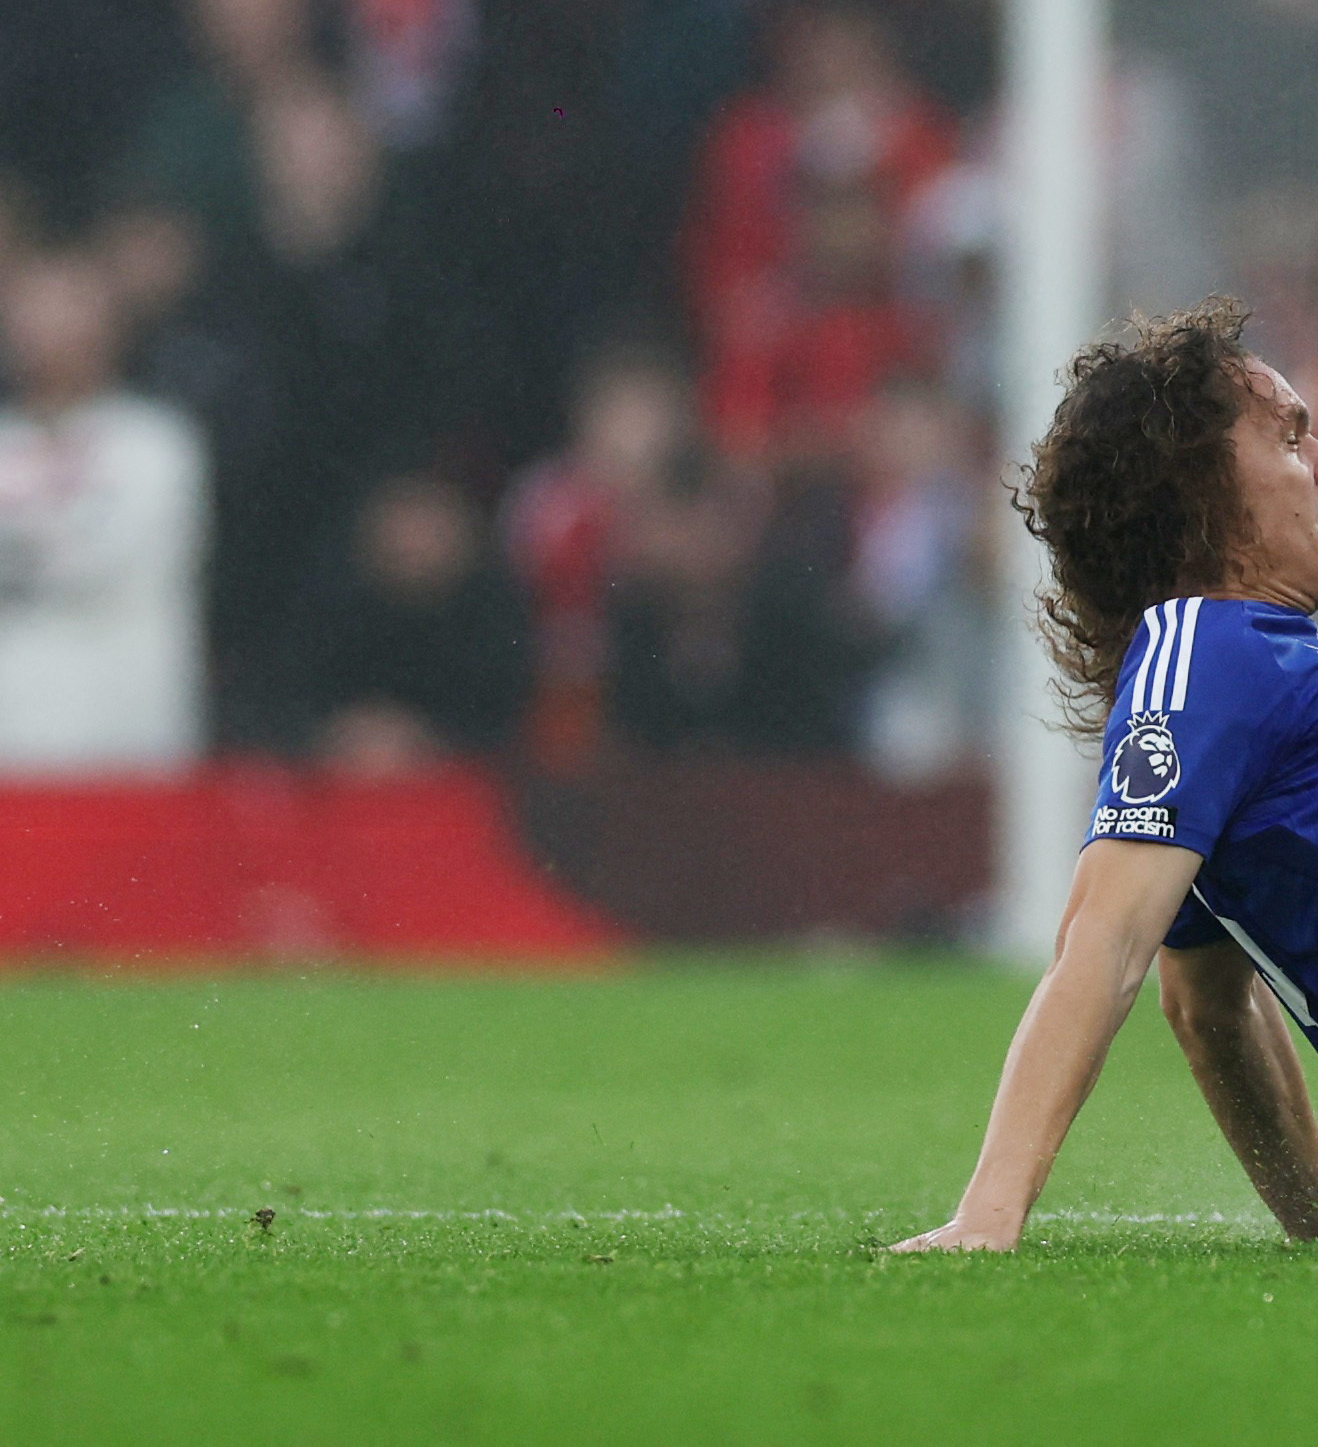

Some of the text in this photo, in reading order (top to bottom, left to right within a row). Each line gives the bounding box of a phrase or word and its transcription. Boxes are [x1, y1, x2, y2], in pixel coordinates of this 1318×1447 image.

[1094, 805, 1169, 822] No room
[1091, 819, 1175, 838] for racism
